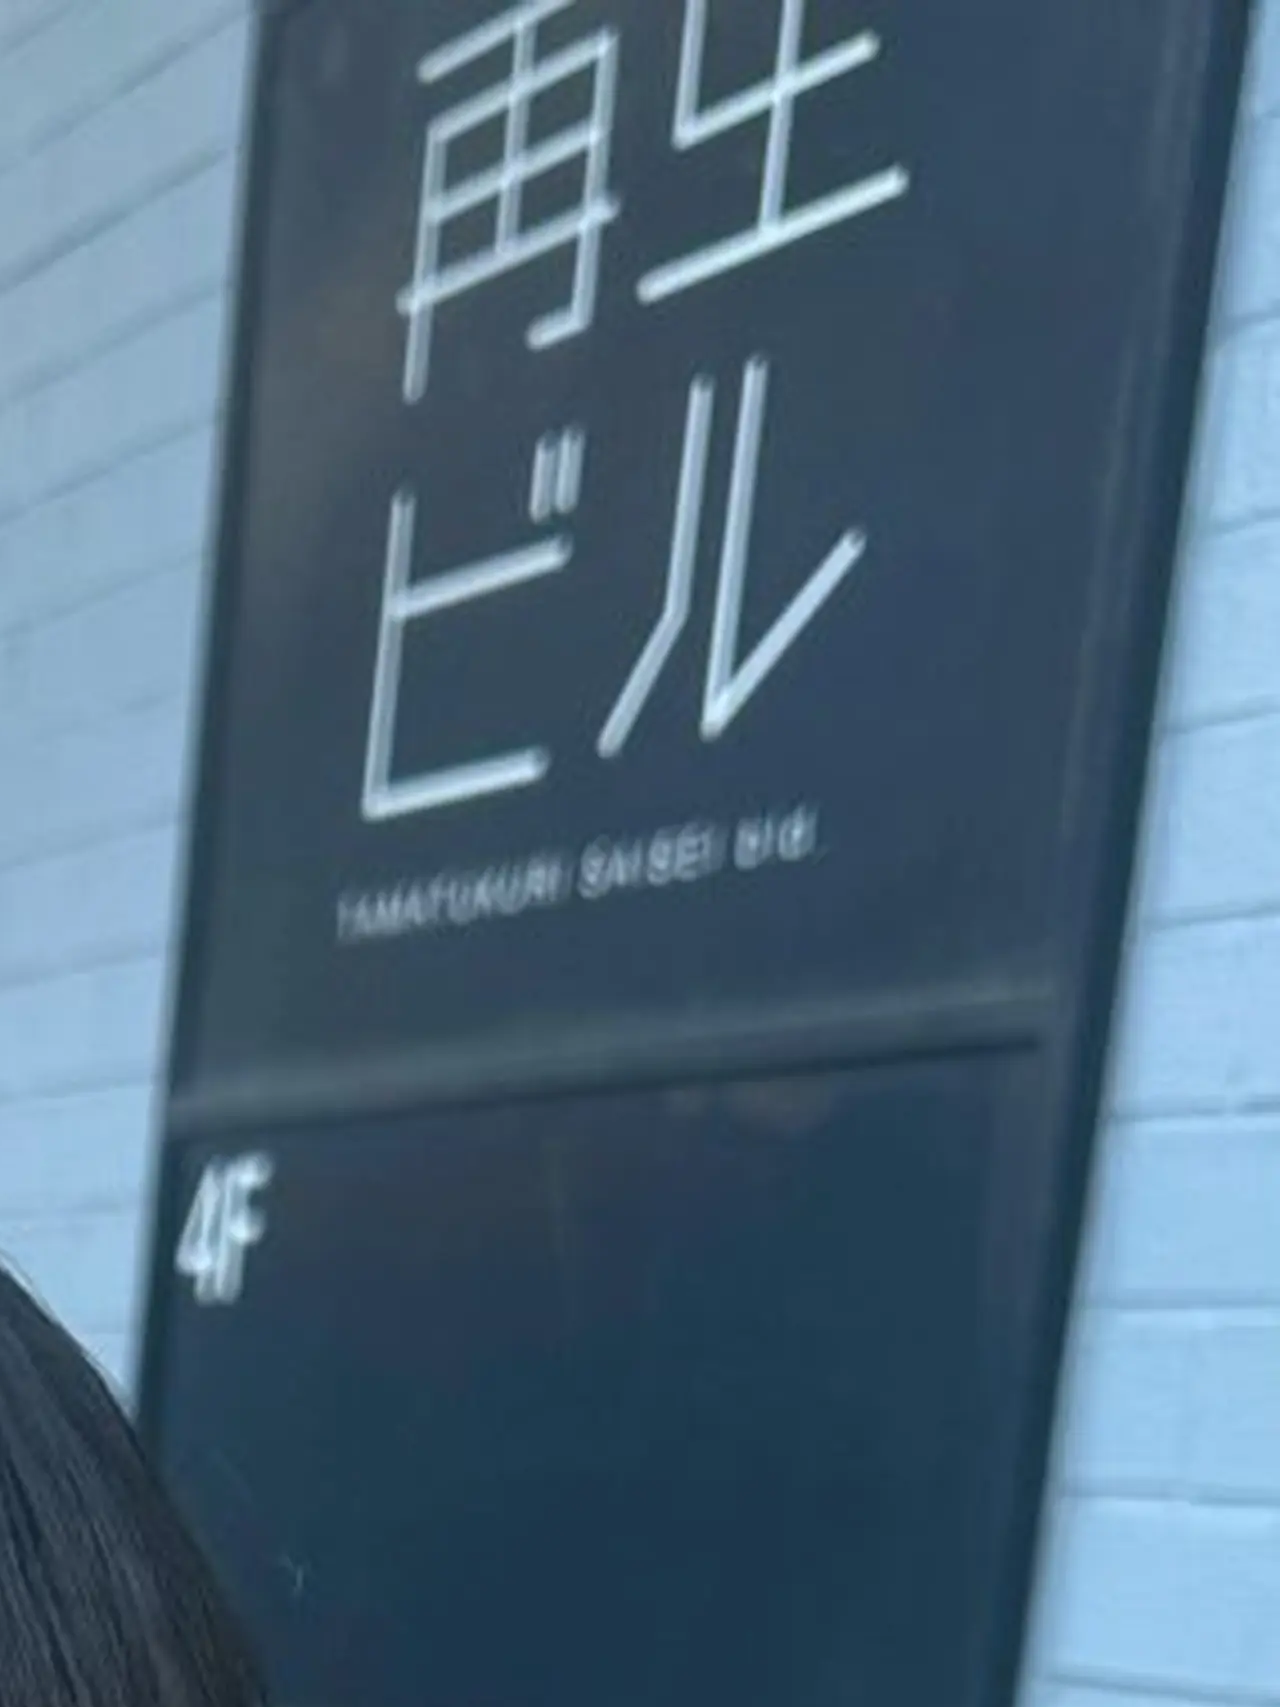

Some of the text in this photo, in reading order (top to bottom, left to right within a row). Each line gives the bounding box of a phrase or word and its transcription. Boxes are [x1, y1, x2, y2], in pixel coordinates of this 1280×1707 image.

[397, 0, 908, 403] 再生
[362, 353, 867, 820] ビル
[173, 1152, 276, 1306] 4F
